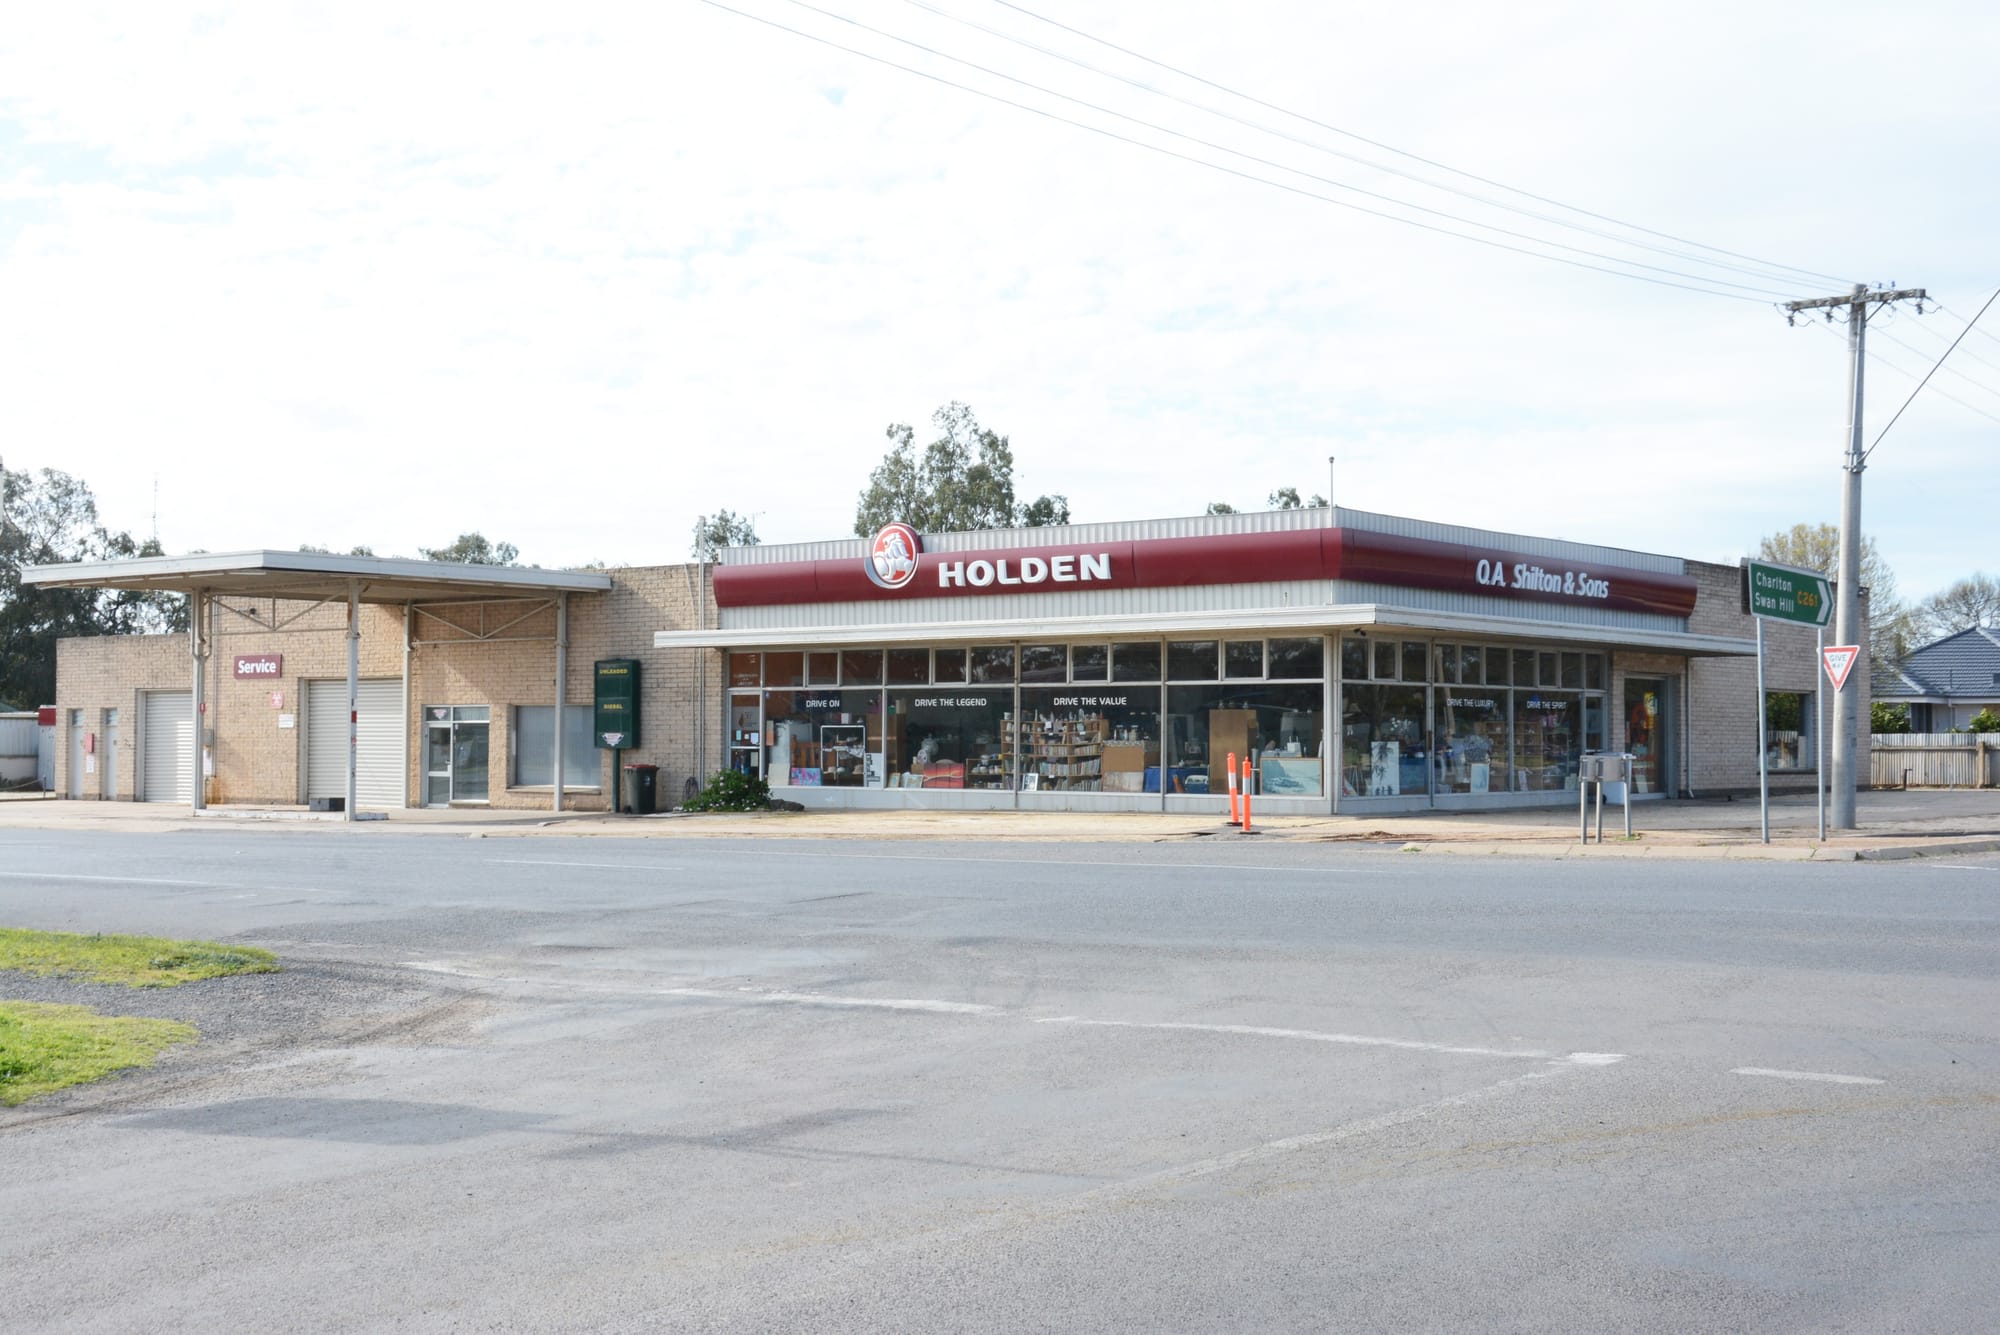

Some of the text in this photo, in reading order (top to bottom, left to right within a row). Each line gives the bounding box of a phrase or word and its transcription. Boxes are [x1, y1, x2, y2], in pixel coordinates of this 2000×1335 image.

[938, 553, 1112, 588] HOLDEN
[1476, 559, 1609, 598] O.A. Shilton & Sons
[1756, 572, 1792, 592] Charlton
[1755, 592, 1794, 613] Swan Hill
[1797, 591, 1818, 607] C261
[1829, 654, 1847, 662] GIVE
[238, 658, 277, 673] Service
[806, 700, 840, 708] DRIVE ON
[915, 698, 987, 707] DRIVE THE LEGEND
[1053, 696, 1127, 706] DRIVE THE VALUE
[1447, 698, 1462, 707] DRIVE
[1463, 698, 1474, 707] THE
[1526, 700, 1567, 709] DRIVE THE SPIRIT
